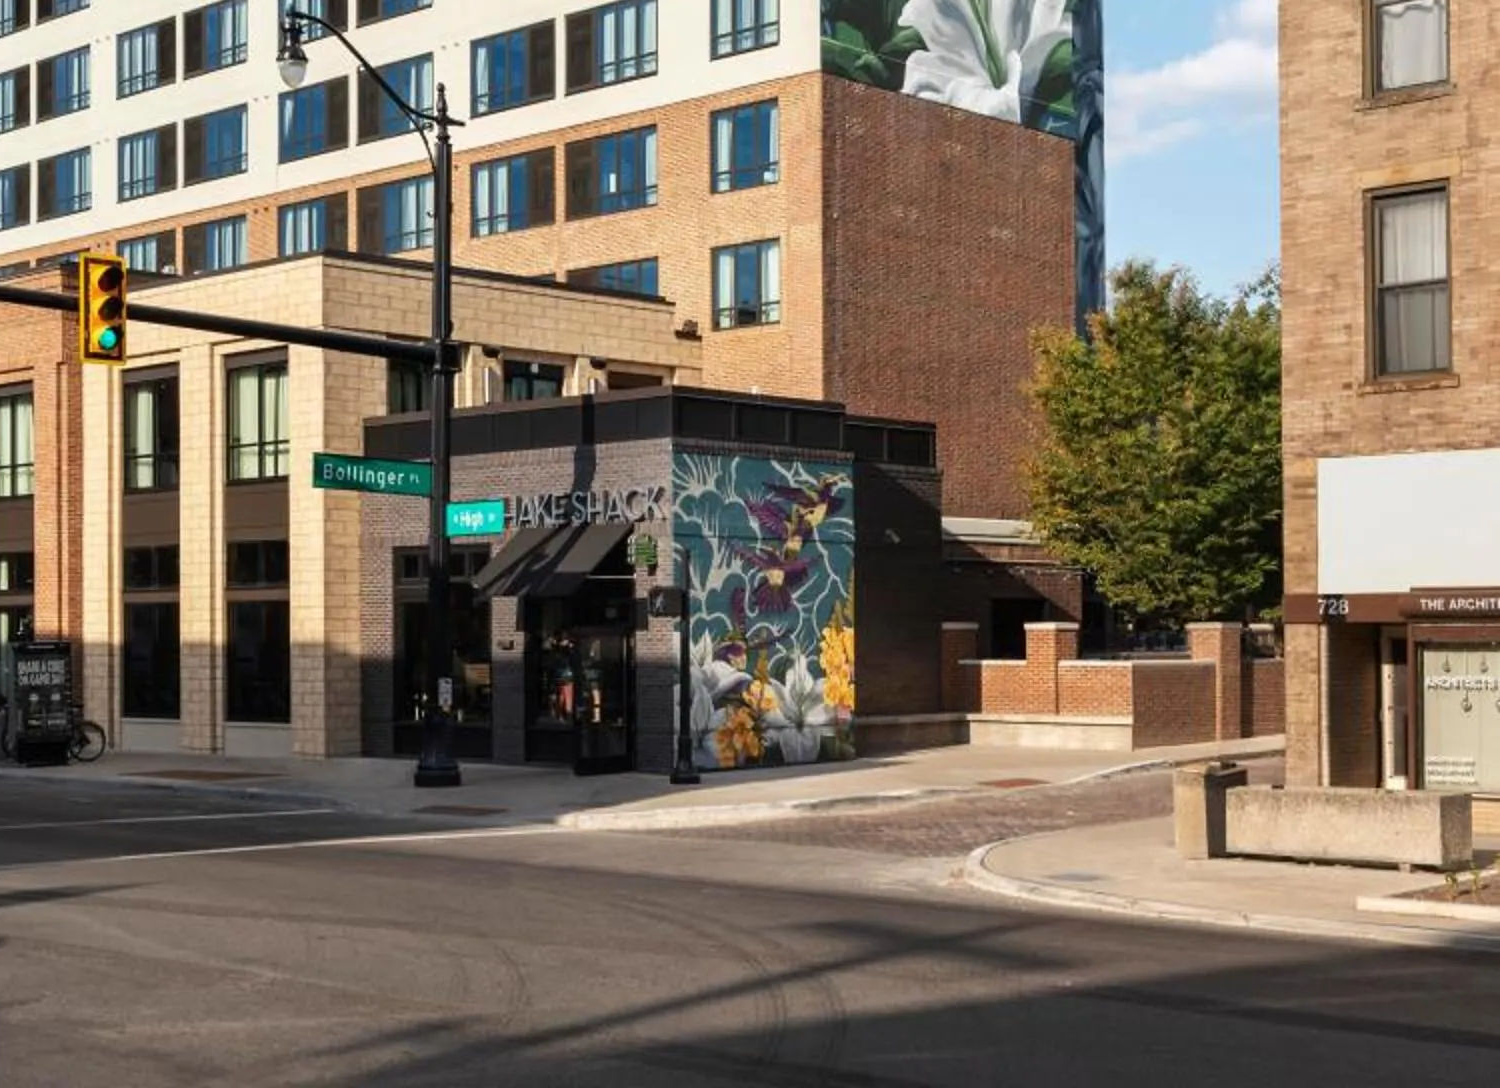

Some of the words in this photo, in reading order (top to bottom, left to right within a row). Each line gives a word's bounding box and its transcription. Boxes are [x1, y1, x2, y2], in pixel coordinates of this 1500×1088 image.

[323, 463, 404, 488] Bollinger
[503, 494, 567, 528] HAKE
[571, 486, 667, 526] SHACK
[460, 511, 483, 531] High
[1317, 598, 1349, 616] 728
[1420, 598, 1445, 611] THE
